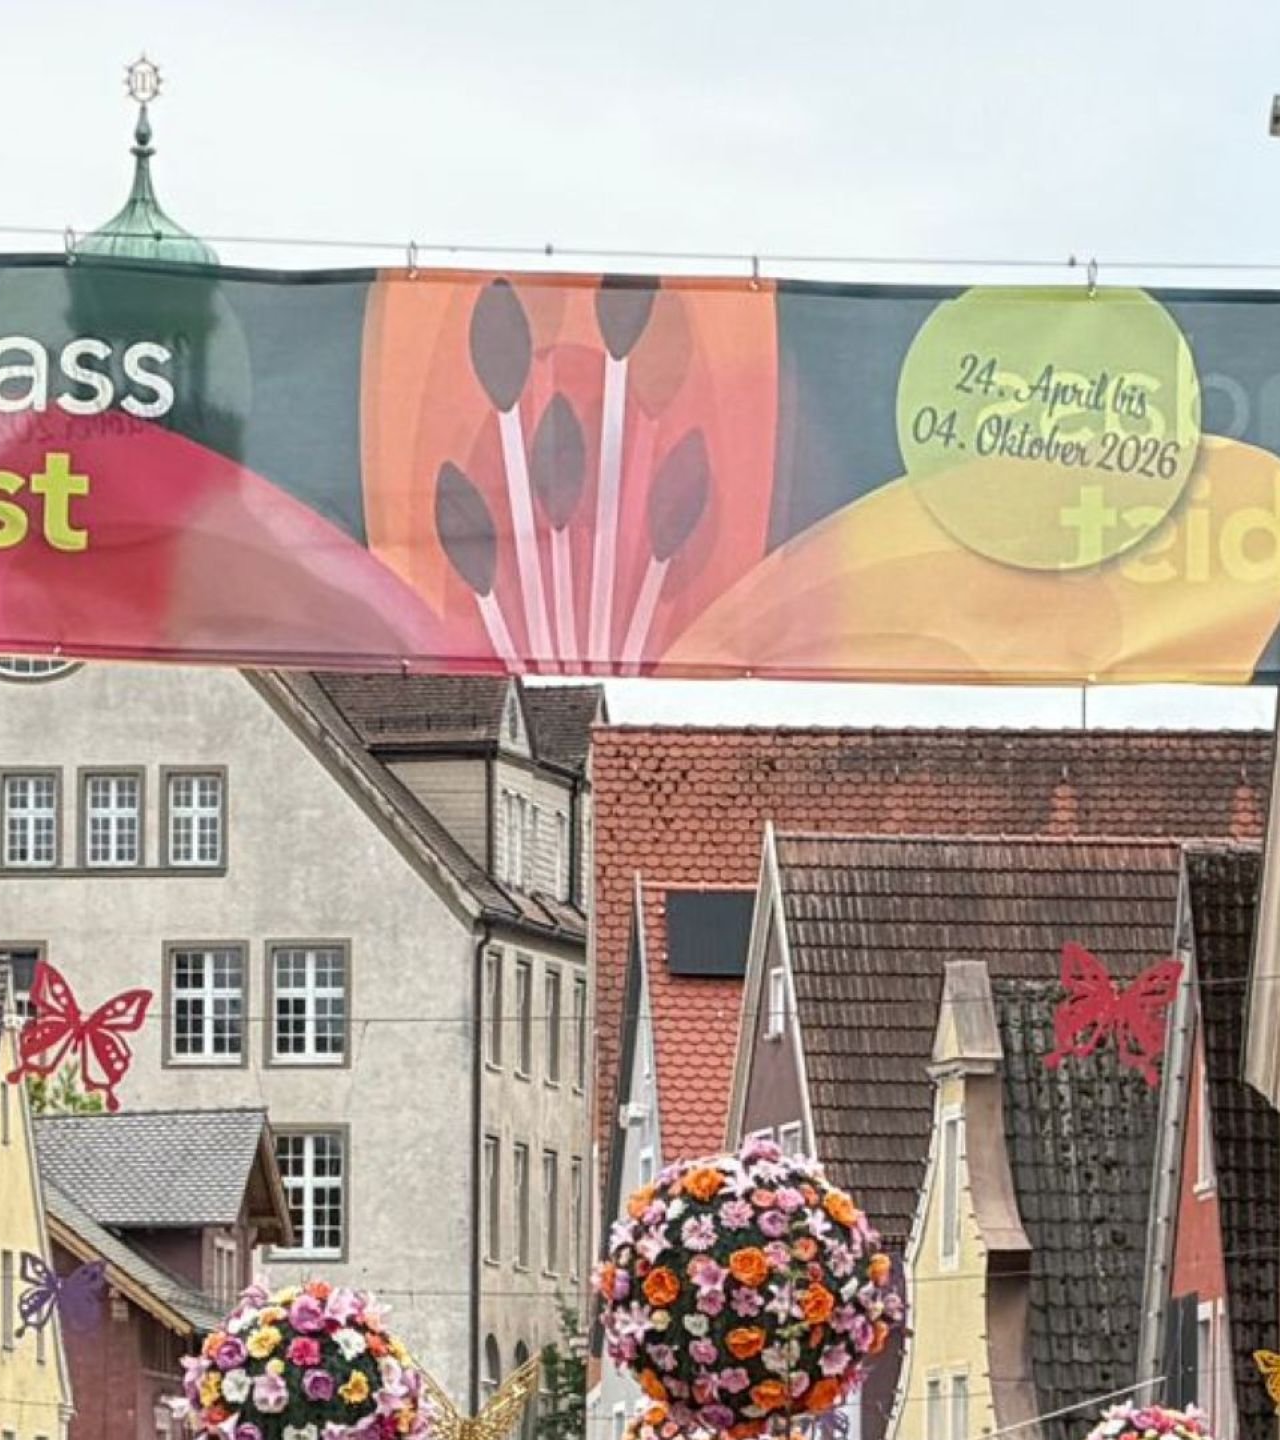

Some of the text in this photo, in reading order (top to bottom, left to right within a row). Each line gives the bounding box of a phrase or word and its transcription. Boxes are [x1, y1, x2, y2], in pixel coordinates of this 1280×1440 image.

[955, 353, 1148, 420] 24. April bis
[911, 406, 1180, 480] 04. Oktober 2026
